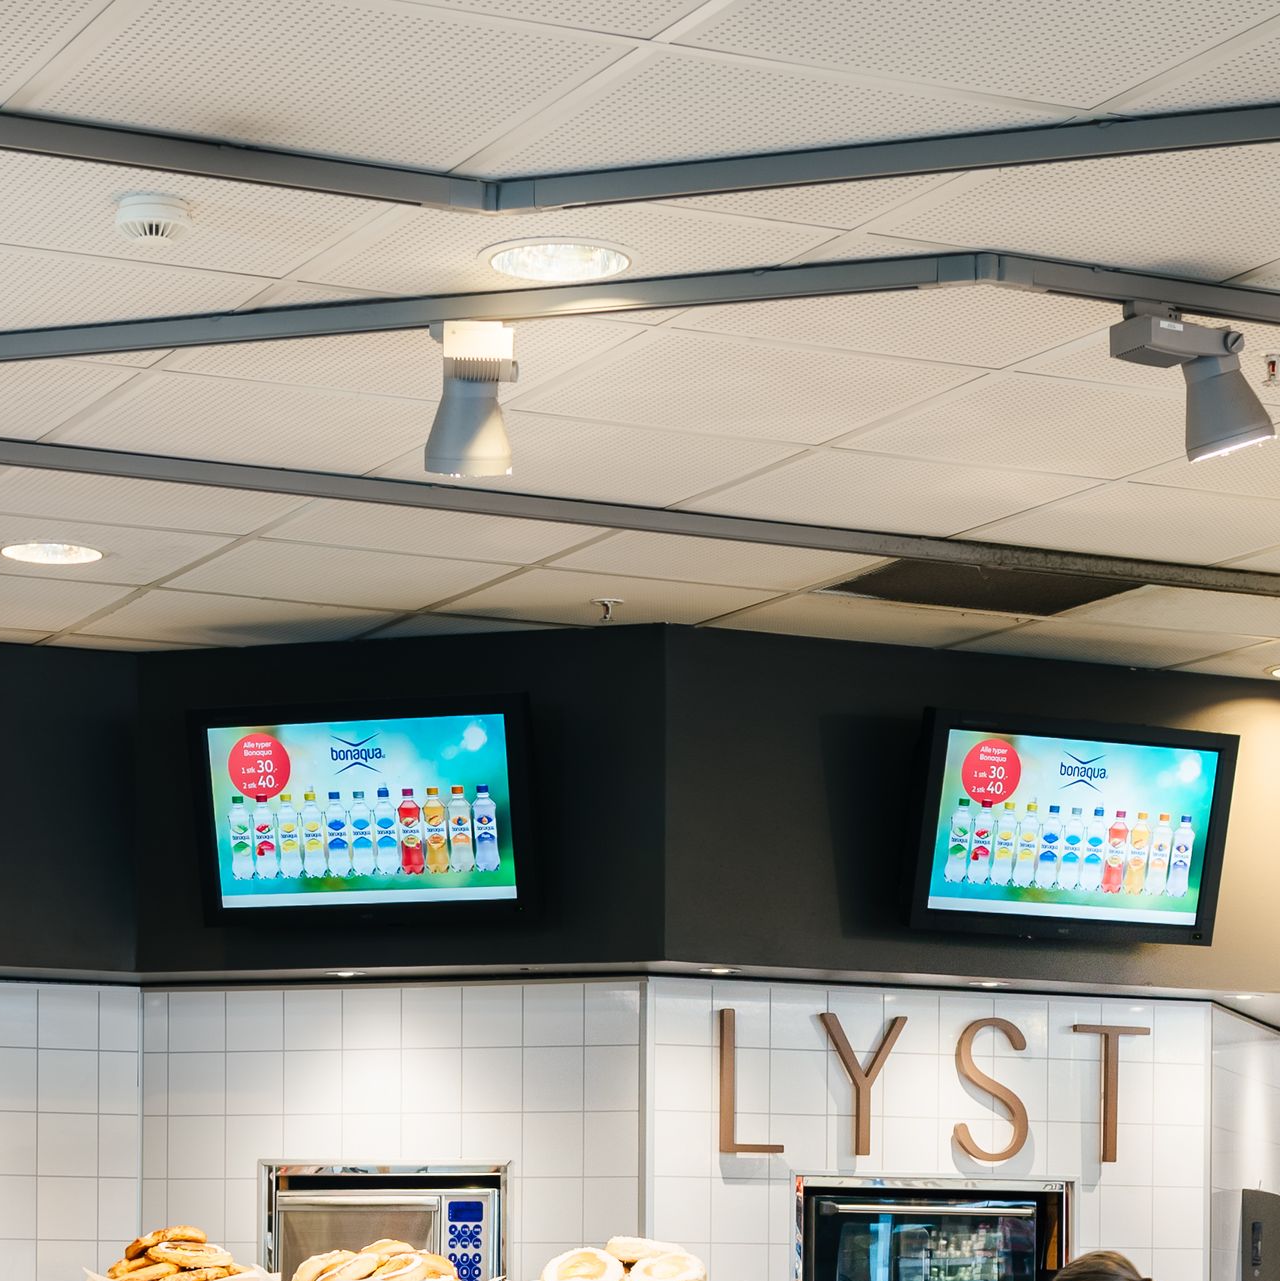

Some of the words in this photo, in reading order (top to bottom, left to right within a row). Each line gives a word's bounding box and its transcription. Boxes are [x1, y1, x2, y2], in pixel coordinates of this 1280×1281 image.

[243, 741, 255, 749] Alle
[255, 741, 272, 750] typer
[243, 749, 272, 757] Bonaqua
[330, 747, 382, 763] bonaqua
[979, 754, 1007, 763] Bonaqua
[246, 766, 256, 774] stk
[257, 760, 278, 773] 30,-
[1059, 761, 1107, 781] bonaqua
[257, 775, 279, 788] 40,-
[977, 785, 986, 794] stk
[986, 781, 1006, 795] 40,-
[719, 1008, 1151, 1163] LYST
